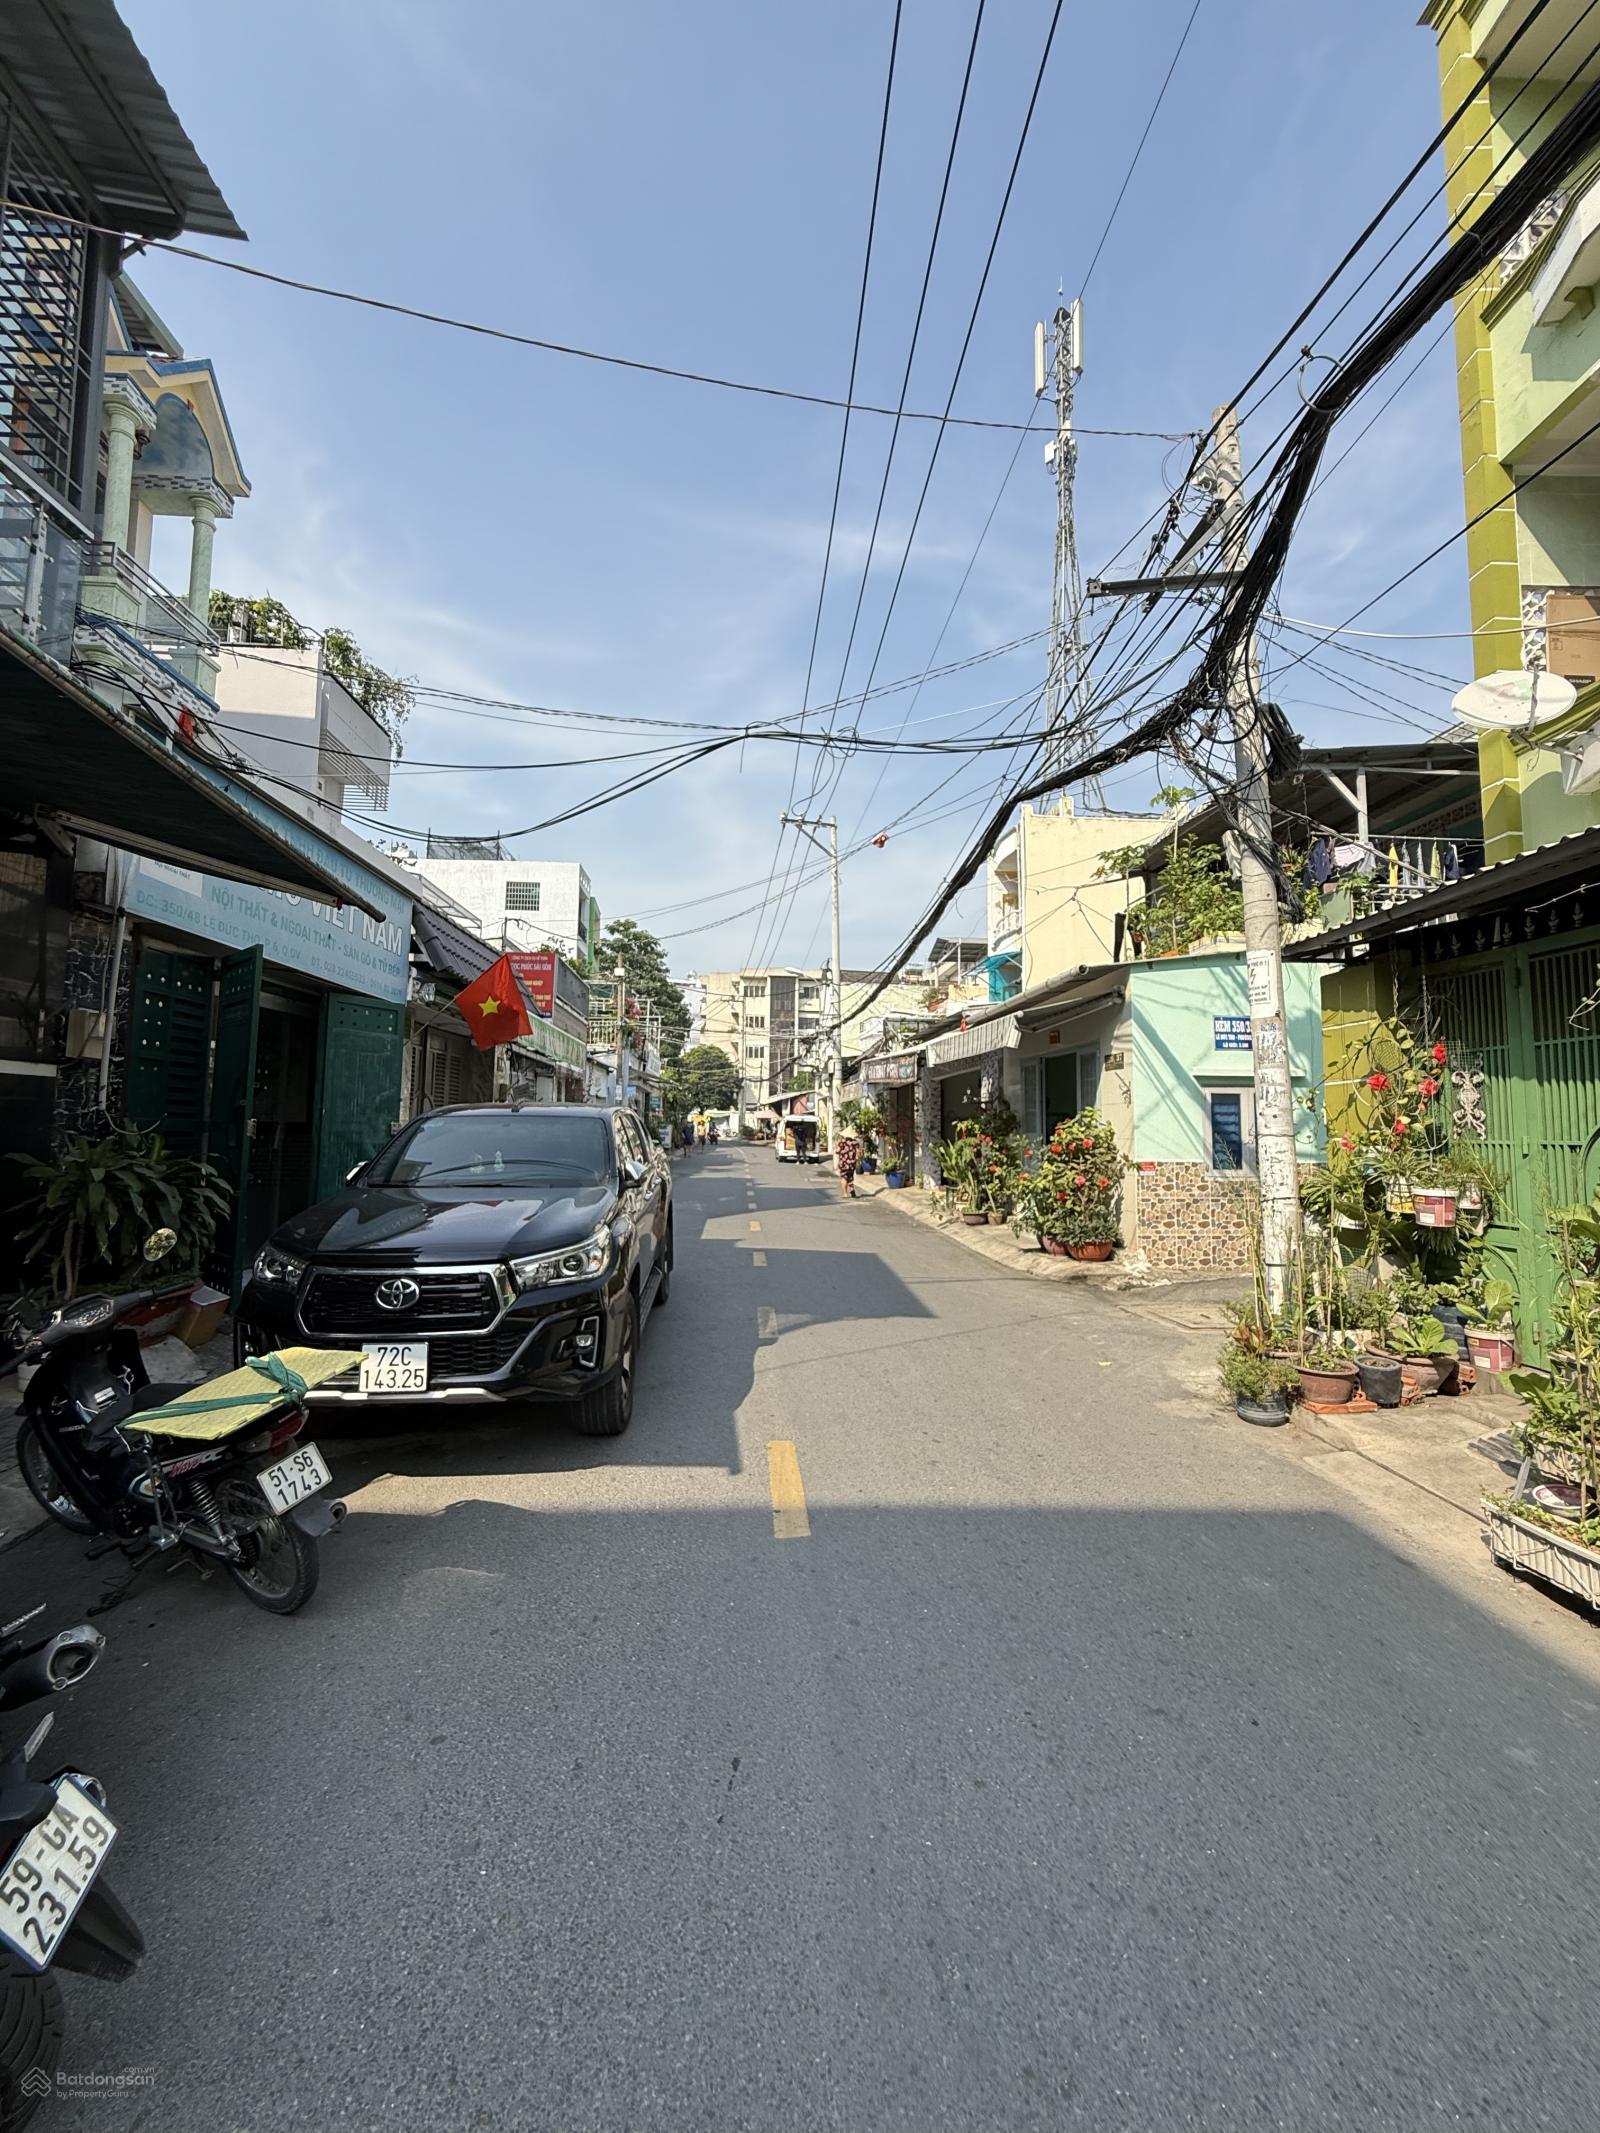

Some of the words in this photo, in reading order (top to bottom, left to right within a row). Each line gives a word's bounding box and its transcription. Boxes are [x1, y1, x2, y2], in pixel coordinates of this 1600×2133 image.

[211, 886, 235, 911] NỘI
[238, 896, 270, 923] THẤT
[271, 911, 279, 928] &
[281, 915, 312, 943] NGOẠI
[312, 929, 337, 951] THẤT
[362, 910, 403, 957] NAM
[364, 1368, 425, 1389] 143.25
[377, 1346, 412, 1367] 72C
[277, 1468, 322, 1506] 1743
[0, 1803, 80, 1914] 59-GA
[22, 1815, 110, 1955] 231.59
